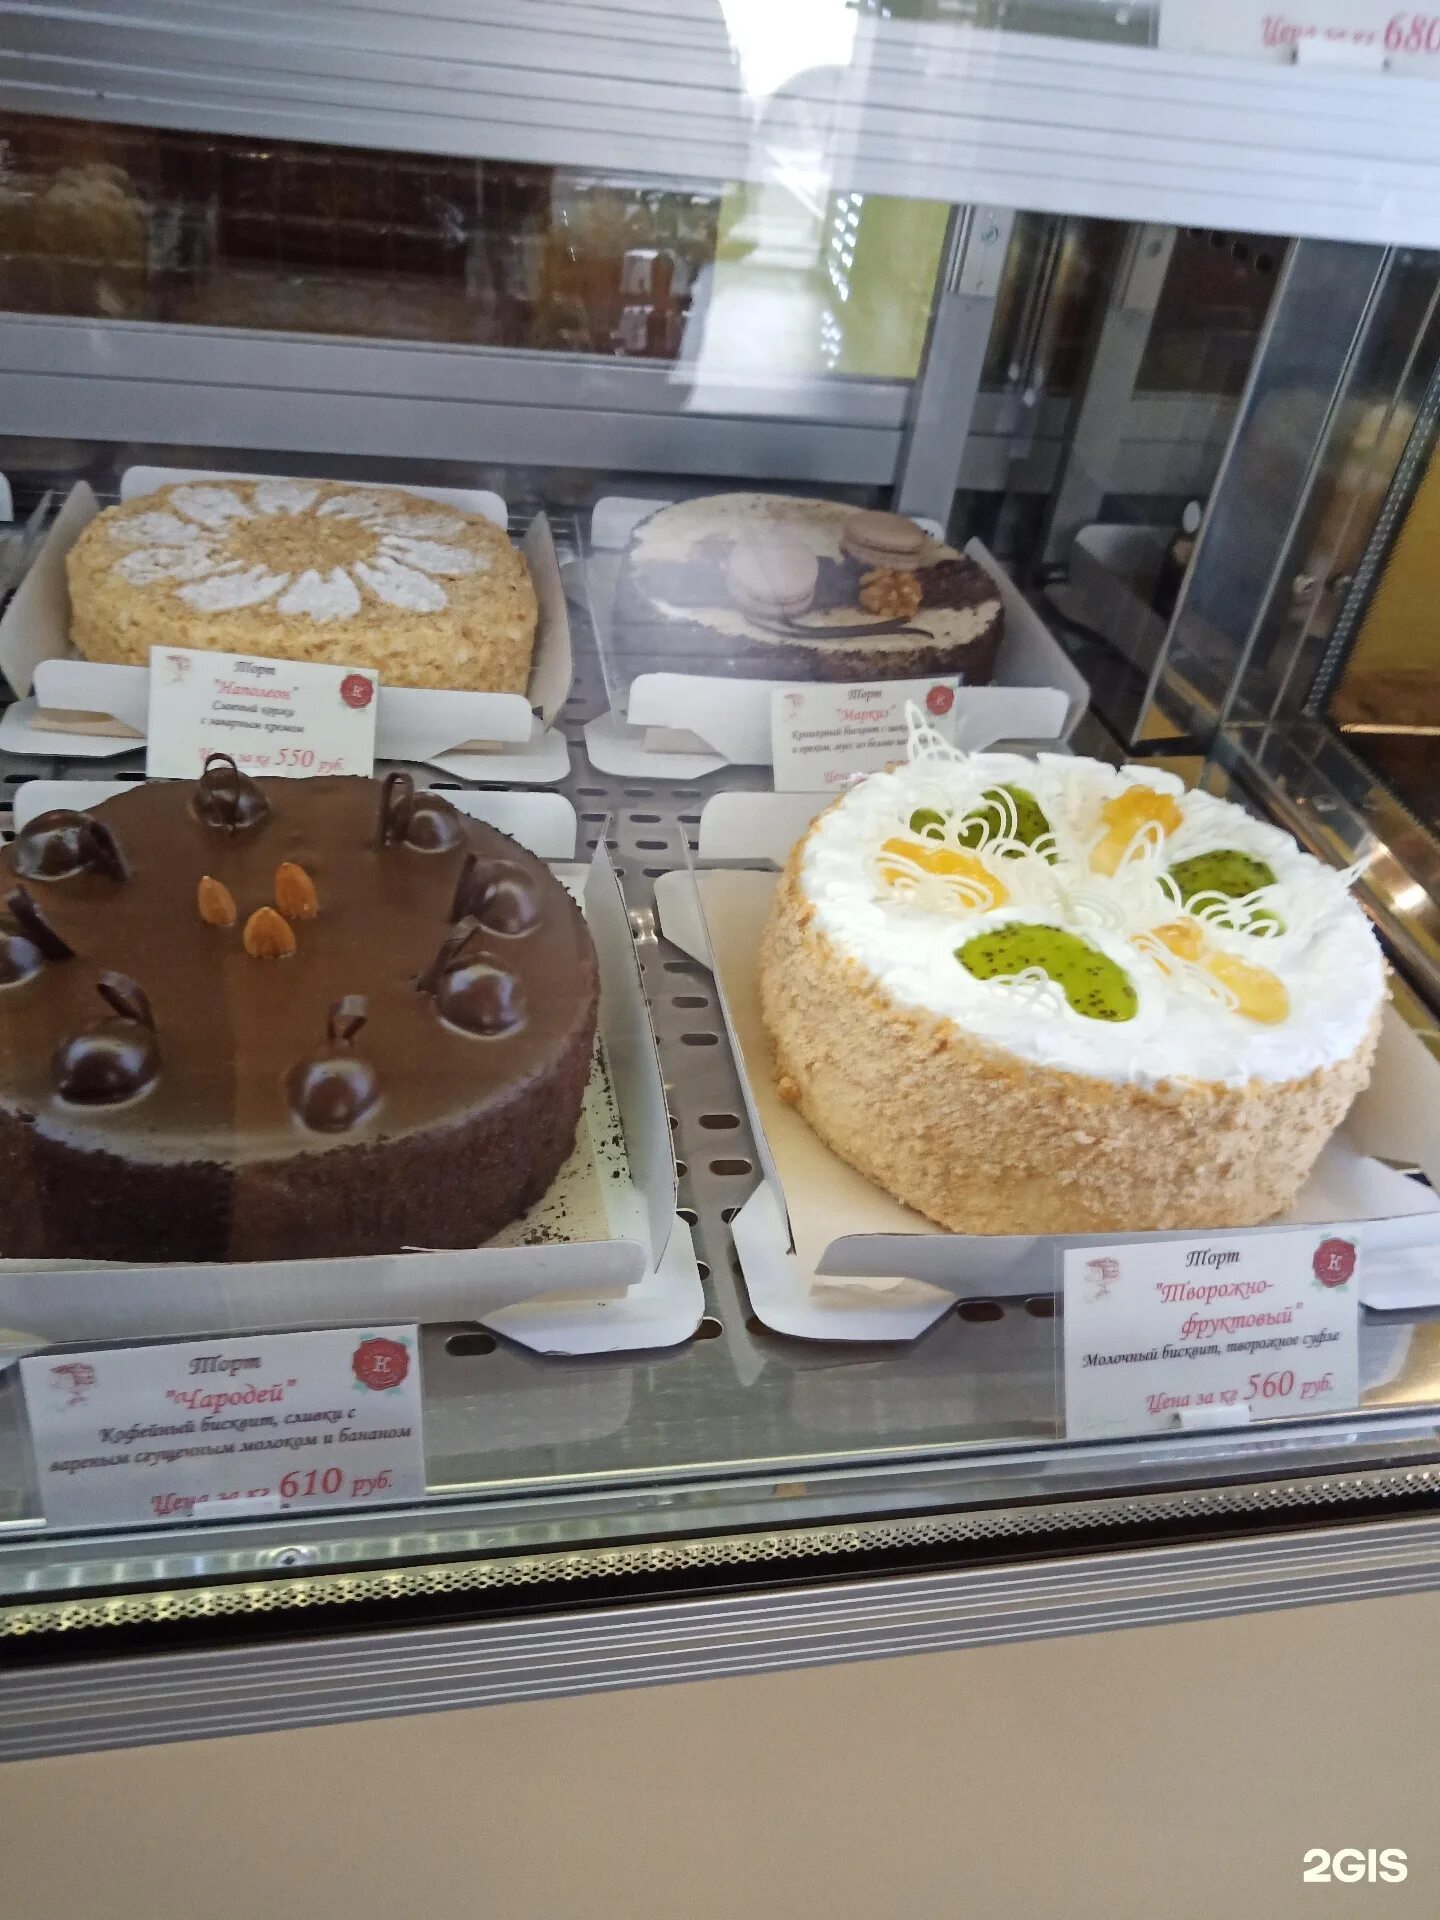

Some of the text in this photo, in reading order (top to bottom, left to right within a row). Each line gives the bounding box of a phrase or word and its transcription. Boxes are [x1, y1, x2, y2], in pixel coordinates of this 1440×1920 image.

[233, 661, 276, 677] Торт
[848, 688, 882, 703] Торт
[275, 748, 315, 767] 550
[1186, 1249, 1240, 1270] Торт
[1156, 1279, 1275, 1304] "Творожно-
[1179, 1302, 1303, 1340] фруктовый"
[1082, 1328, 1340, 1368] Молочный бисквит, творожное суфле
[188, 1353, 263, 1376] Торт
[165, 1379, 298, 1414] "Чародей"
[1145, 1370, 1333, 1414] Цена за кг 560 руб.
[100, 1407, 357, 1445] Кофейный бисквит, сливки с
[49, 1425, 412, 1475] вареным сгущенным молоком и бананом
[279, 1467, 343, 1499] 610
[351, 1470, 393, 1497] руб.
